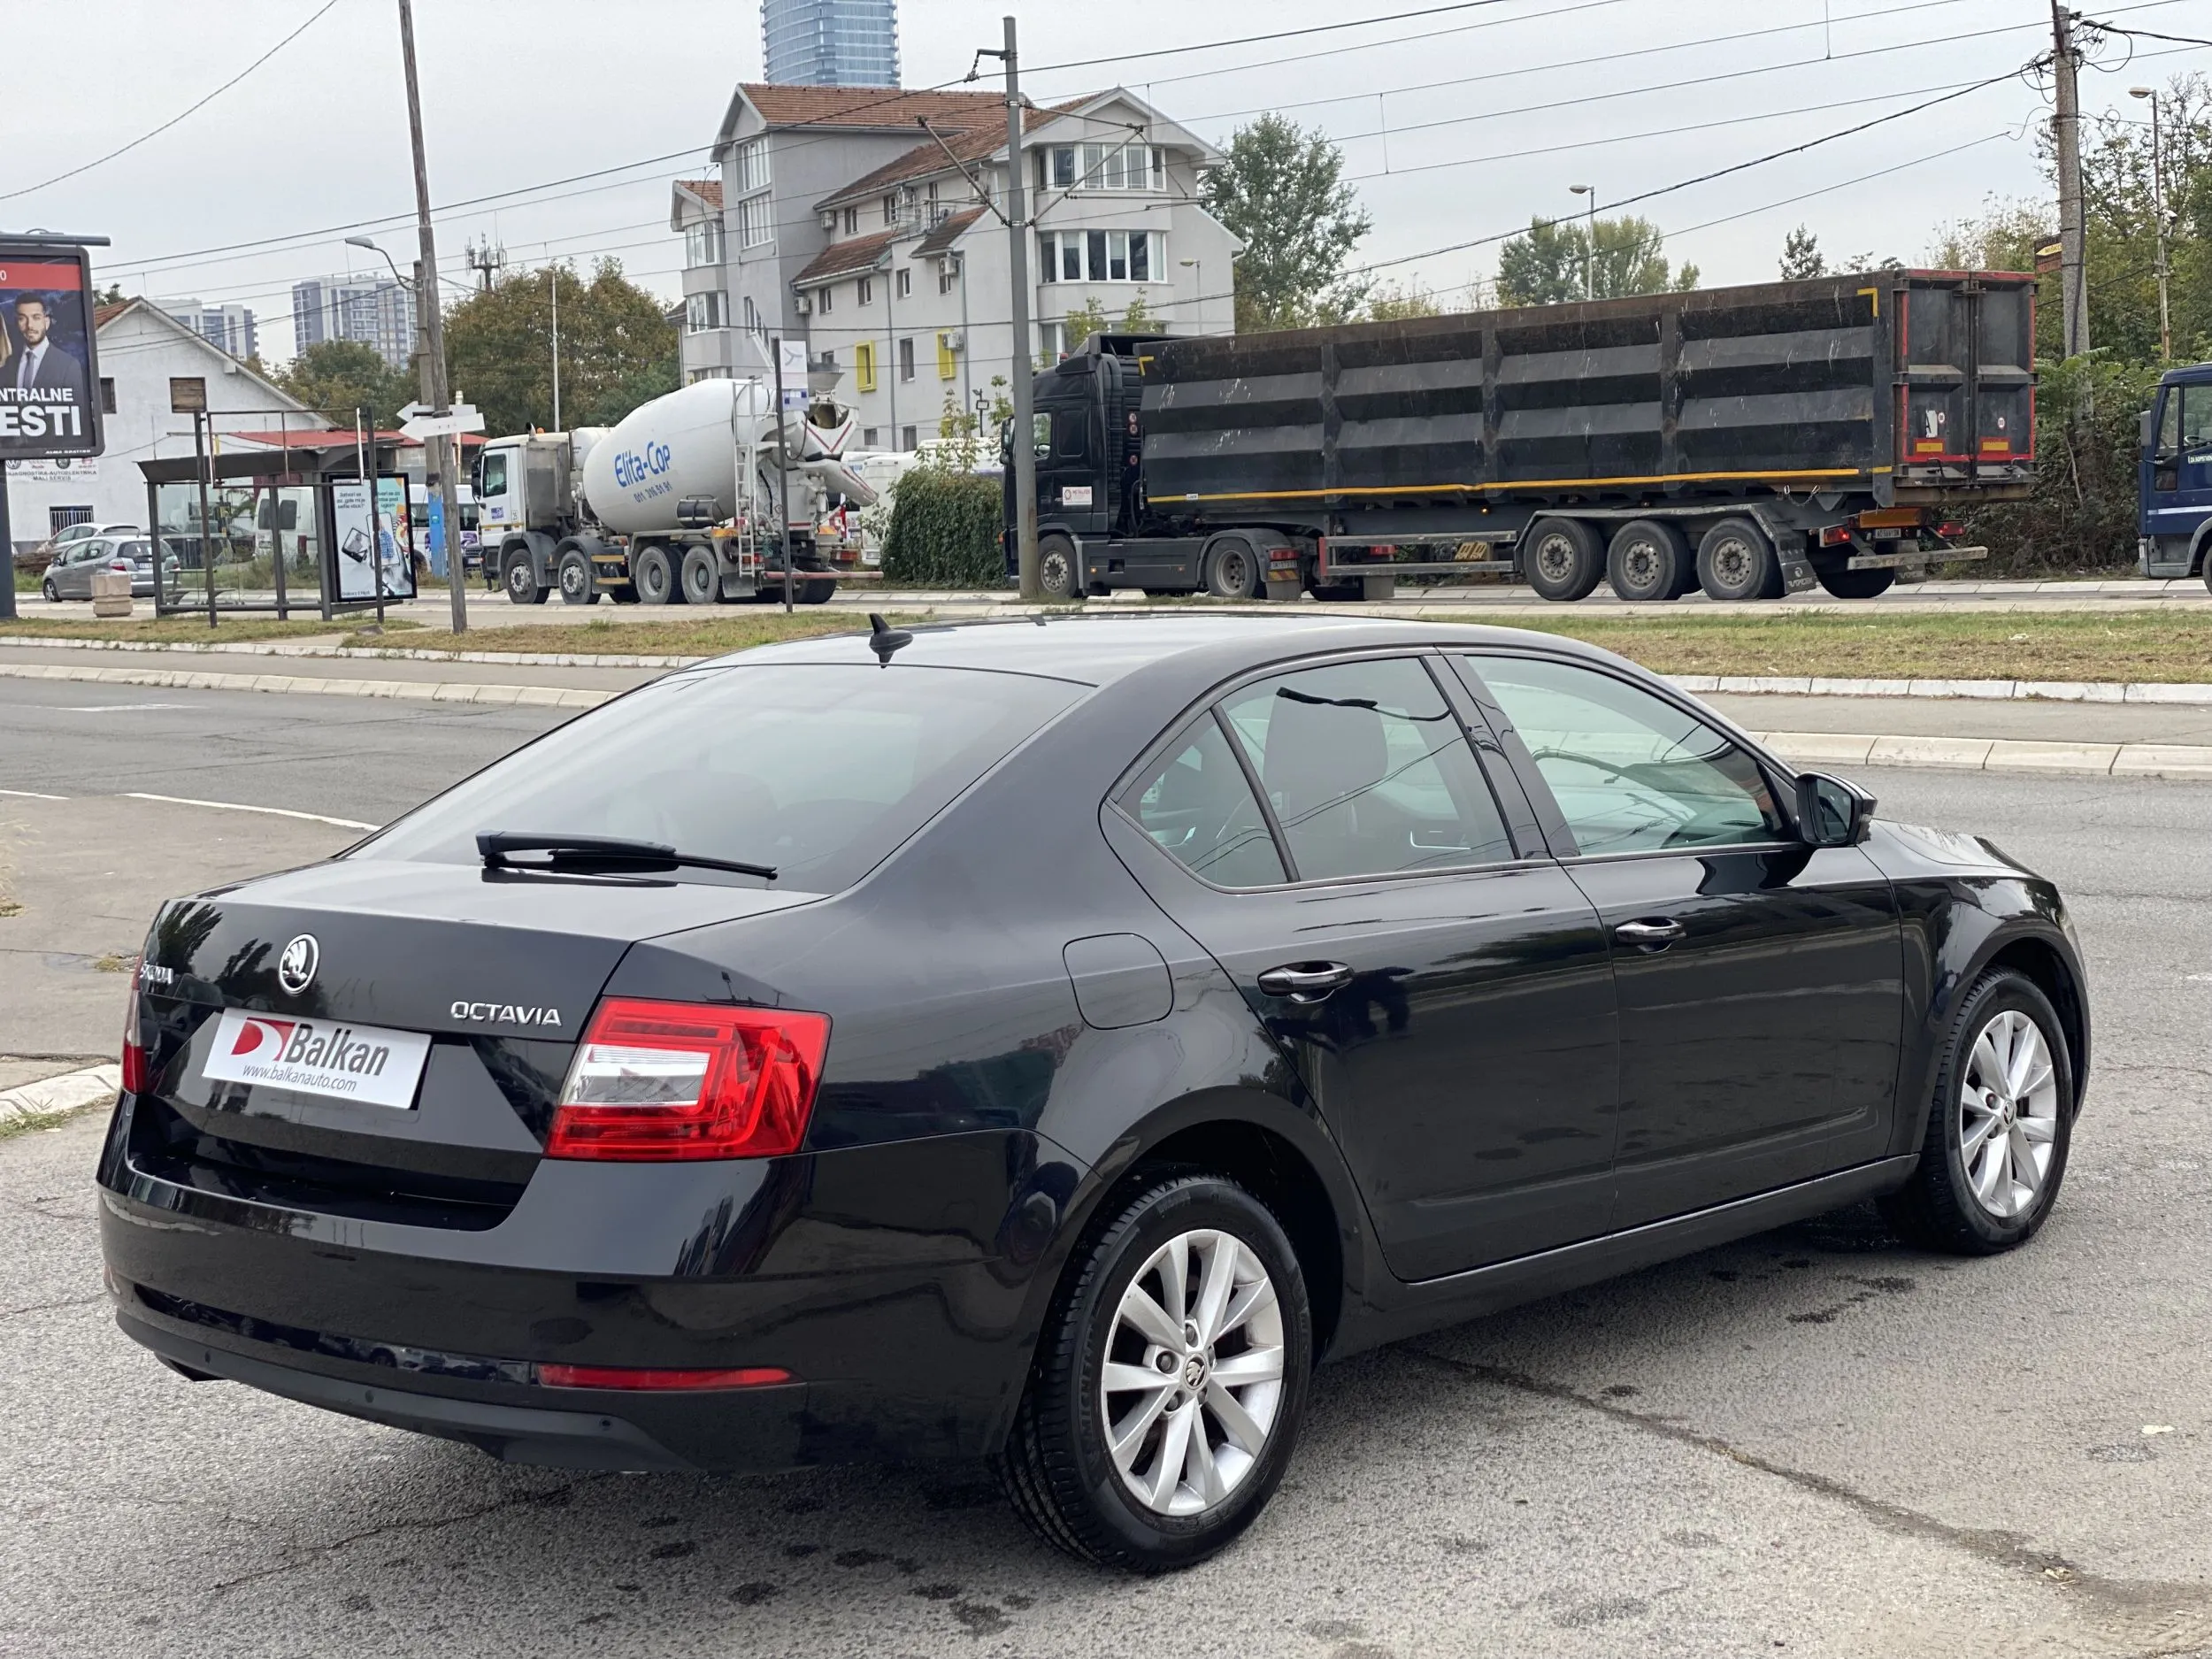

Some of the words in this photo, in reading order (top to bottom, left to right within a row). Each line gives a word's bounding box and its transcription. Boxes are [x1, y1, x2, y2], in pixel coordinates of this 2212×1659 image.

[0, 405, 81, 437] ESTI
[449, 1000, 563, 1027] OCTAVIA
[287, 1021, 390, 1077] Balkan
[242, 1063, 357, 1093] www.balkanauto.com
